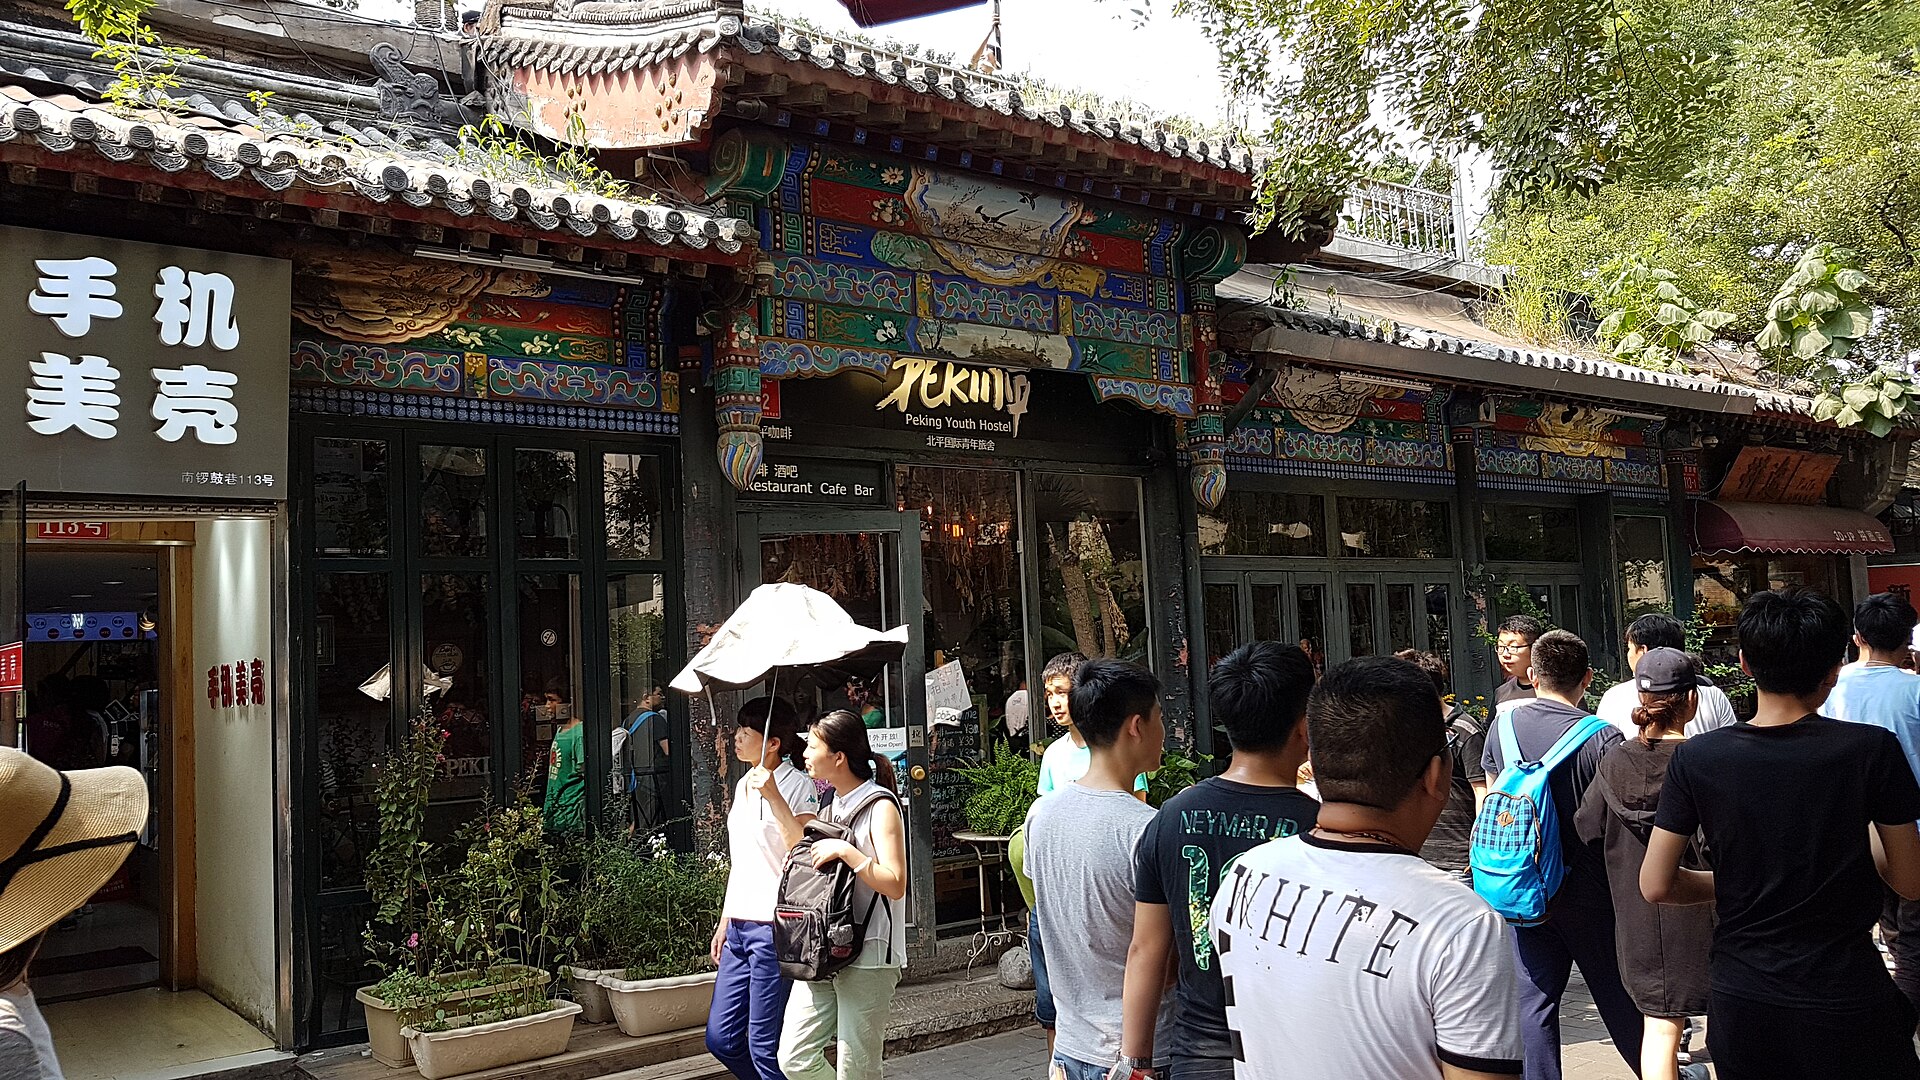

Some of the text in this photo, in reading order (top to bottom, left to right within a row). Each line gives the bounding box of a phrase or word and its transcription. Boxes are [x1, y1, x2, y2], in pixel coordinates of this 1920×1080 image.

[28, 256, 240, 350] 手机
[26, 352, 239, 444] 美壳
[905, 413, 1012, 432] Peking Youth Hostel
[181, 471, 275, 487] 南锣鼓巷113号
[774, 463, 798, 478] 酒吧
[820, 482, 847, 495] Cafe
[854, 484, 875, 497] Bar
[1178, 809, 1269, 840] NEYMAR
[1225, 863, 1420, 980] WHITE
